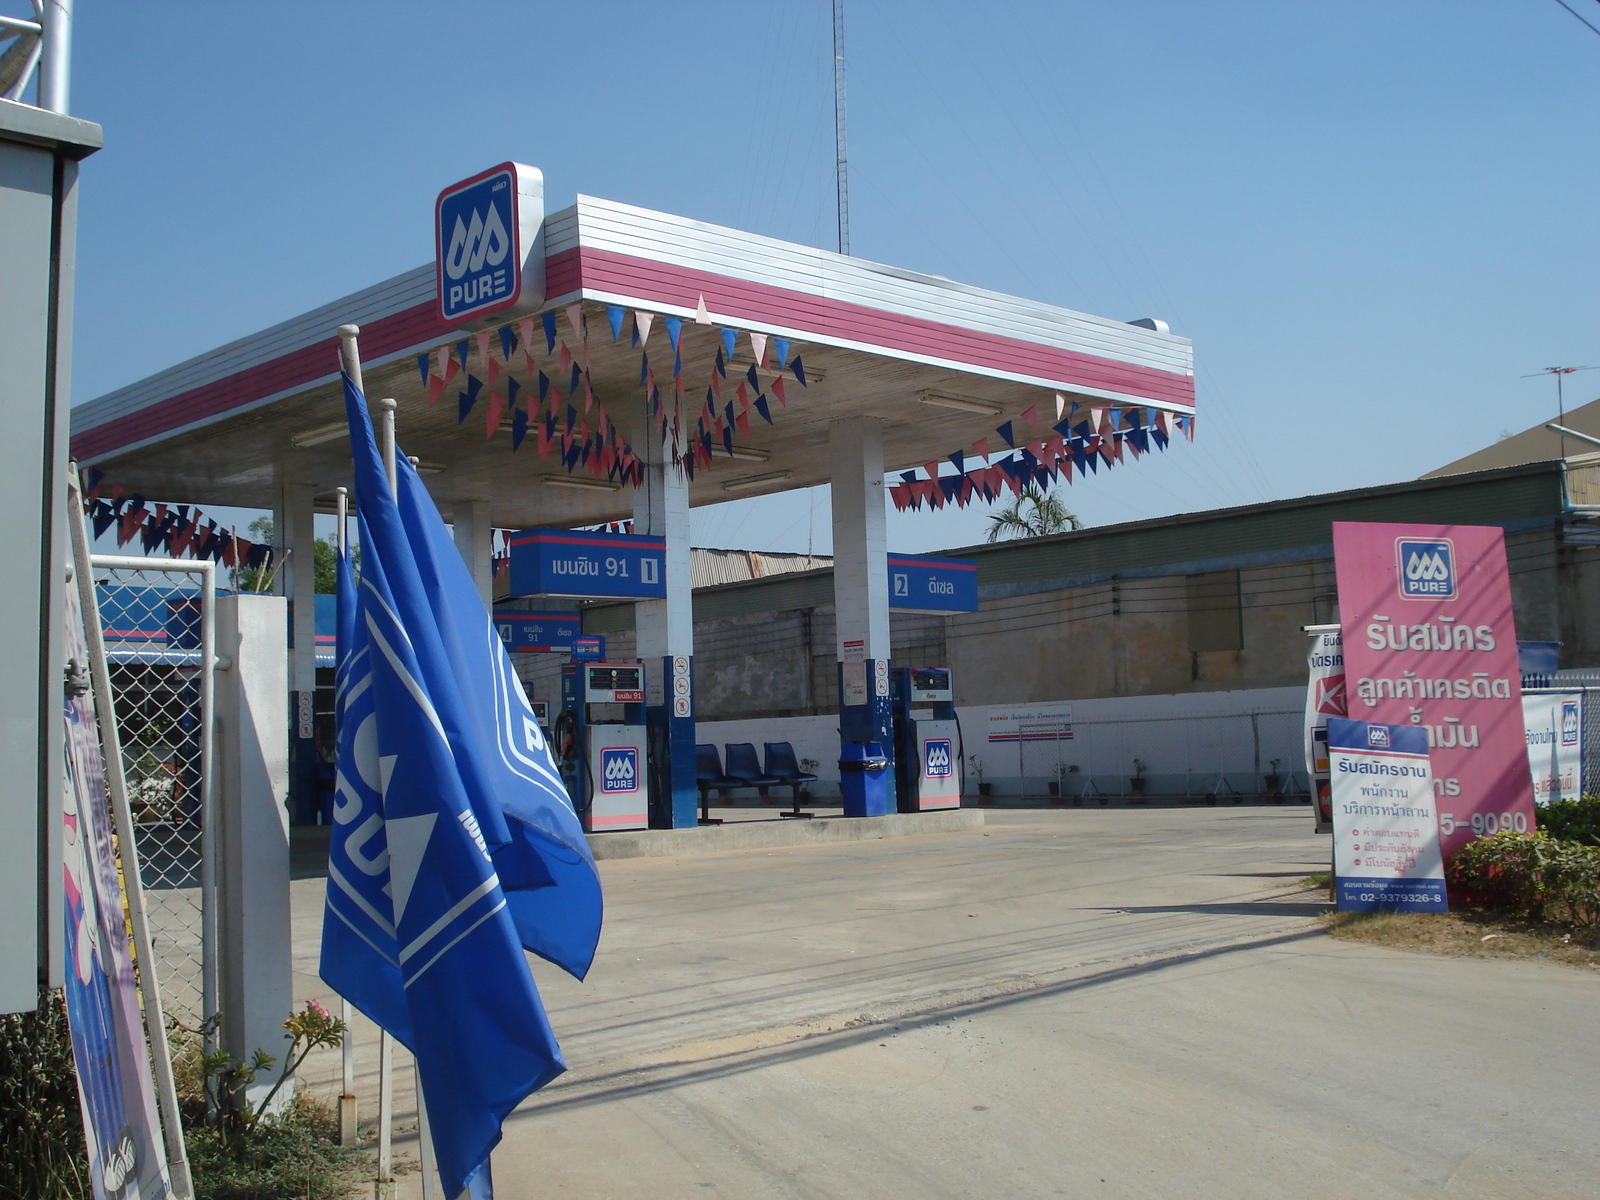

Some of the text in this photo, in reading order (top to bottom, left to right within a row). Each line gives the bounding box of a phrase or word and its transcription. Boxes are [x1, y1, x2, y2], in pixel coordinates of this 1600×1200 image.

[450, 269, 506, 309] PURE
[605, 558, 629, 578] 91
[645, 561, 653, 582] 1
[896, 576, 906, 594] 2
[1409, 581, 1448, 592] PURE
[528, 633, 538, 642] 91
[1366, 614, 1496, 652] รับสมัคร
[1357, 670, 1512, 708] ลูกค้าเครดิต
[1409, 706, 1480, 749] ้ำมัน
[928, 766, 950, 775] PURE
[1339, 757, 1427, 779] รับสมัครงาน
[607, 779, 633, 789] PURE
[1360, 782, 1409, 798] พนักงาน
[1343, 800, 1430, 818] บริการหน้าลาน
[1360, 892, 1442, 903] 02-9379326-8
